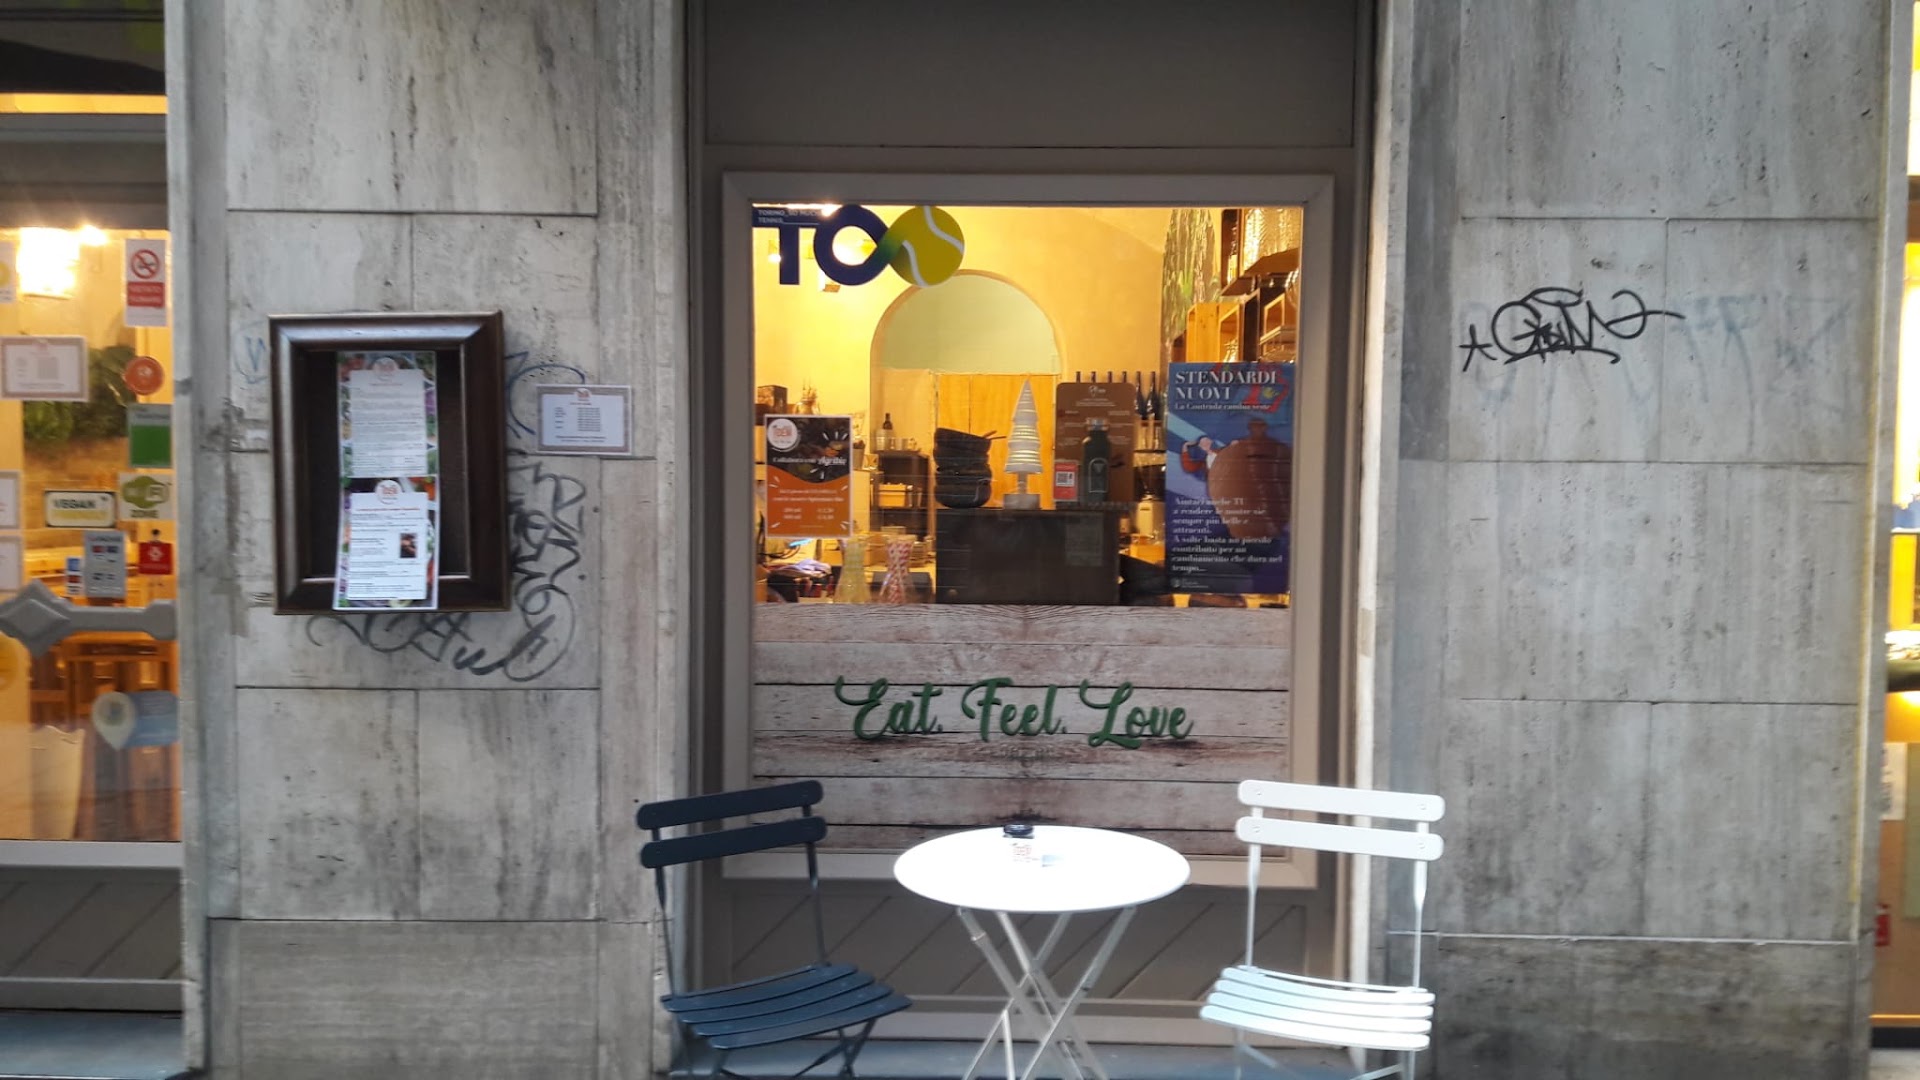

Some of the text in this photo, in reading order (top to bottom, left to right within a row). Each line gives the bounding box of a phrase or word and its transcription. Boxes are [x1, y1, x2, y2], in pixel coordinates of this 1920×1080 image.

[1175, 370, 1276, 385] STENDARDI
[1175, 386, 1231, 400] NUOVI
[834, 674, 1194, 750] Eat. Feel. Love
